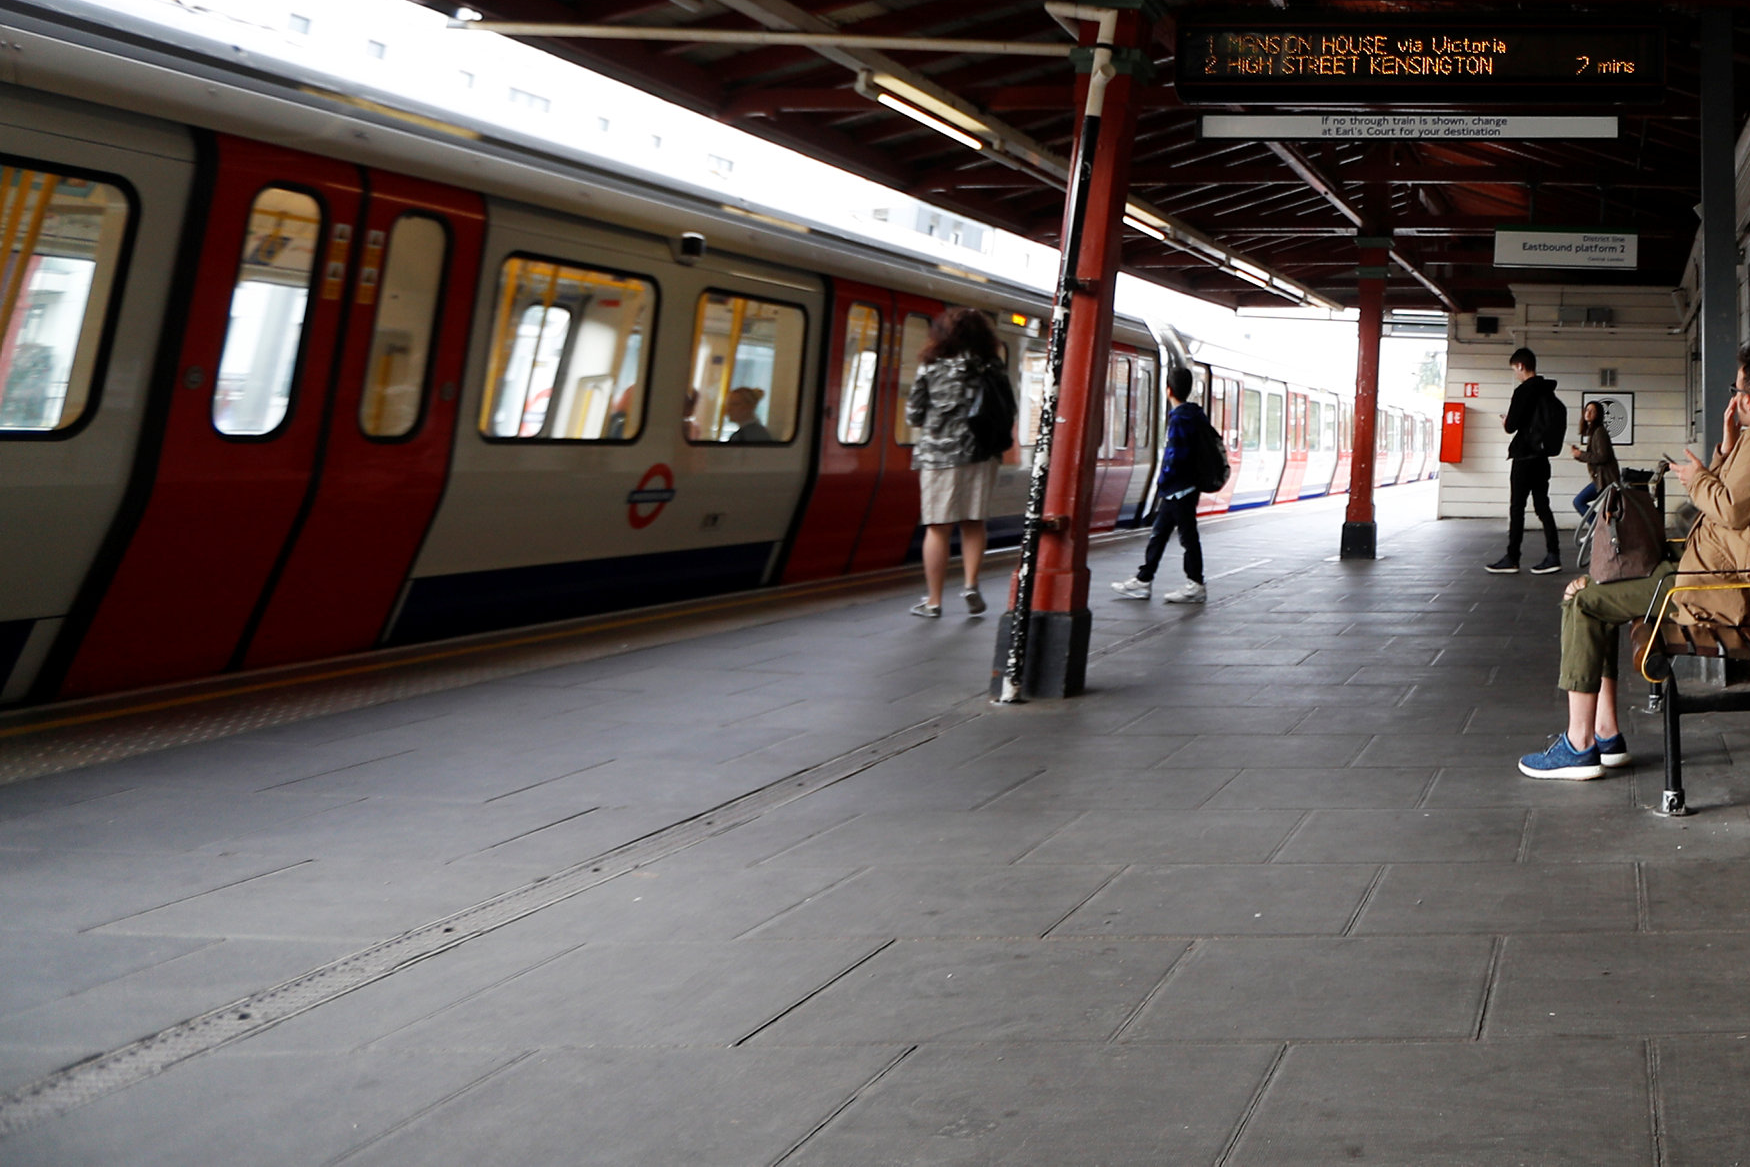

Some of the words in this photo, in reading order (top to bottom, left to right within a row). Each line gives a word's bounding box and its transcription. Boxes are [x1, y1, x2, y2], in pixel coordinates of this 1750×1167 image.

[1228, 35, 1312, 54] MANSON
[1322, 35, 1388, 55] HOUSE
[1397, 38, 1424, 53] via
[1432, 36, 1506, 55] Victoria
[1204, 55, 1217, 74] 2
[1227, 56, 1273, 74] HIGH
[1281, 55, 1360, 74] STREET
[1370, 55, 1493, 75] KENSINGTON
[1597, 59, 1635, 74] mins
[1321, 116, 1329, 125] If
[1350, 116, 1389, 127] through
[1393, 117, 1416, 125] train
[1419, 117, 1428, 125] is
[1431, 116, 1468, 126] shown,
[1471, 116, 1508, 127] change
[1321, 128, 1332, 136] at
[1335, 127, 1363, 136] Earl's
[1366, 127, 1396, 136] Court
[1400, 127, 1415, 136] for
[1418, 129, 1441, 138] your
[1443, 127, 1501, 136] destination
[1522, 242, 1573, 252] Eastbound
[1575, 244, 1617, 254] platform
[1619, 245, 1625, 253] 2
